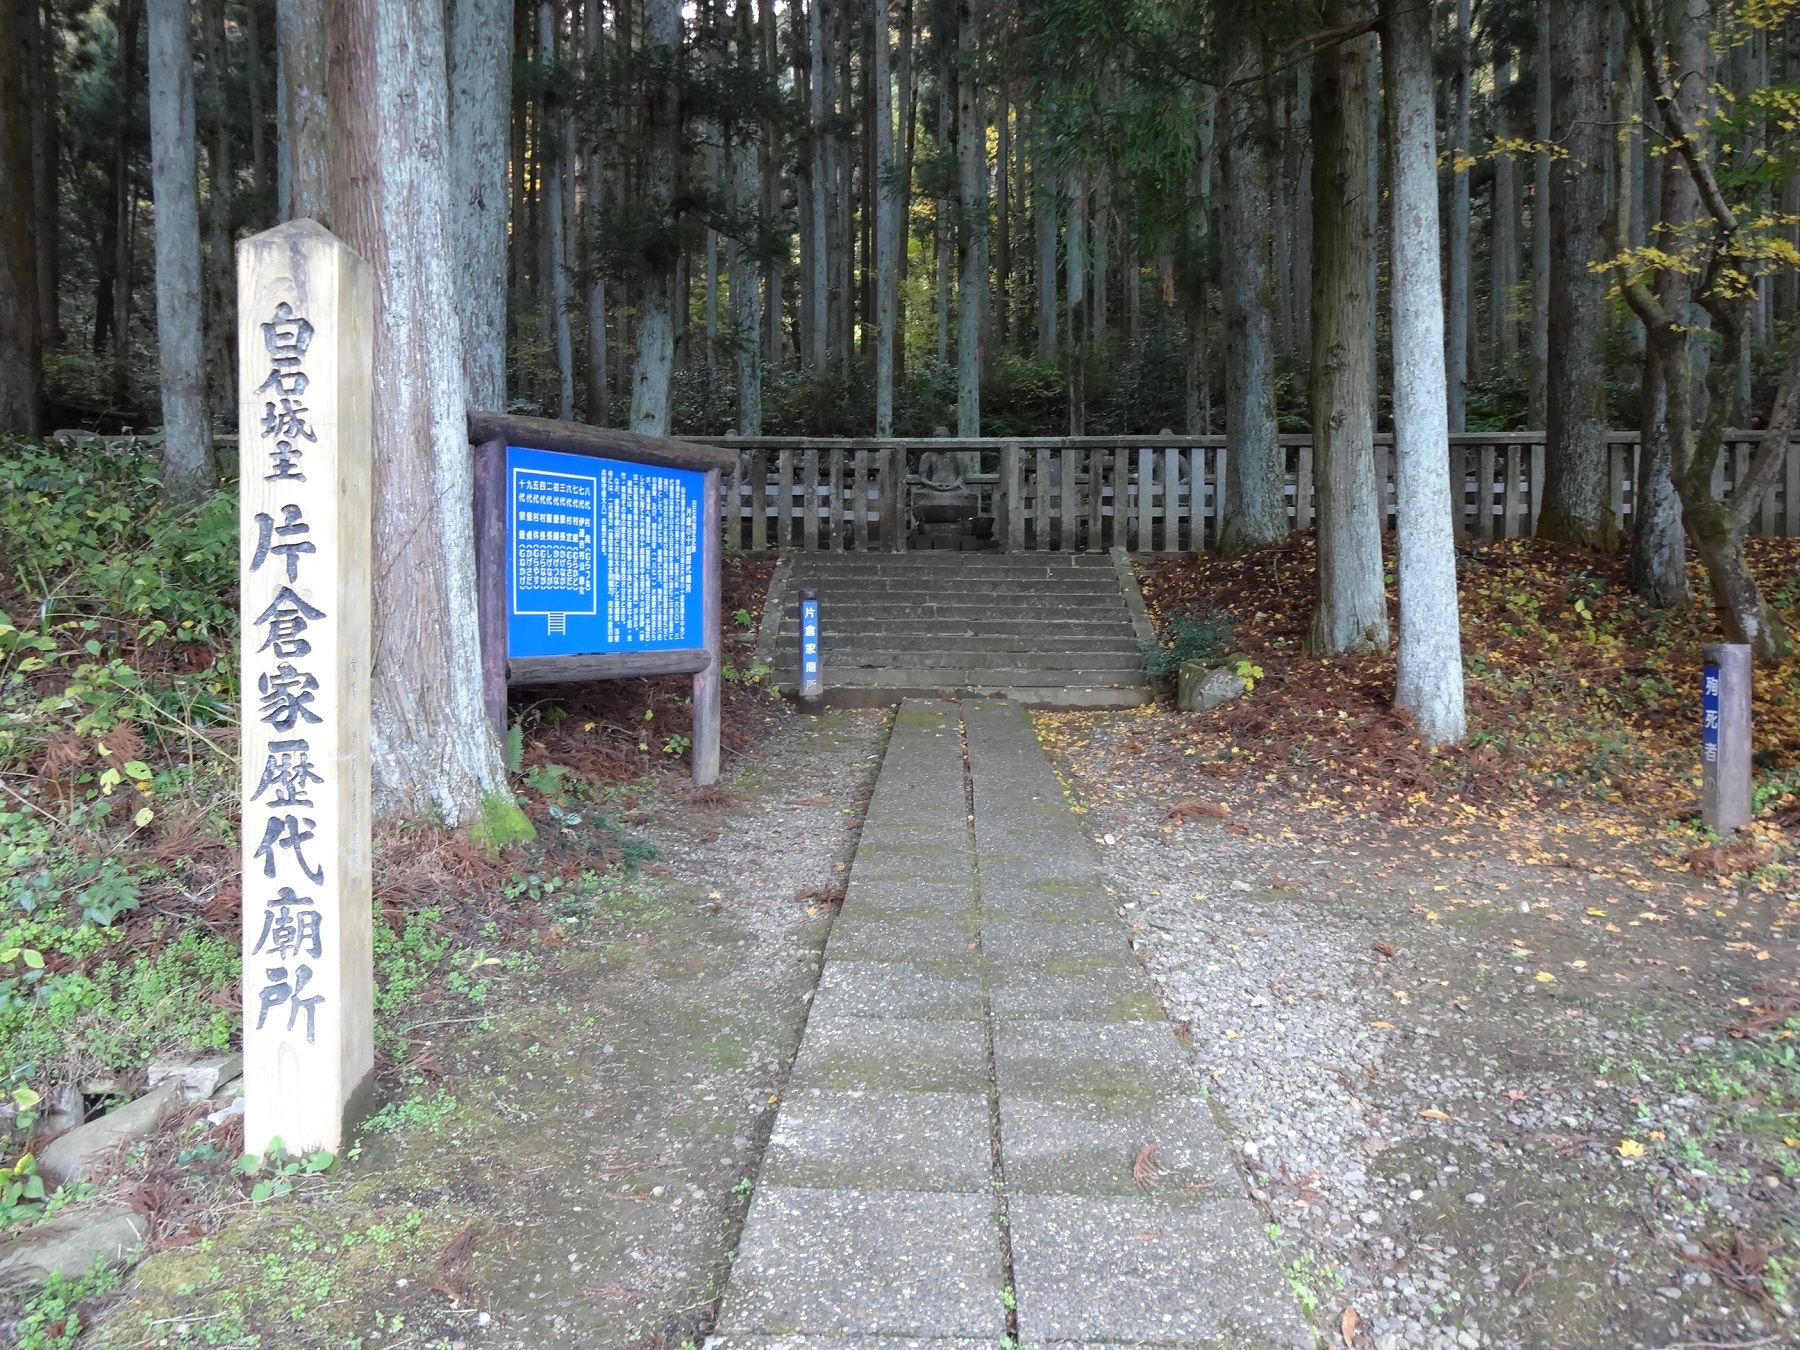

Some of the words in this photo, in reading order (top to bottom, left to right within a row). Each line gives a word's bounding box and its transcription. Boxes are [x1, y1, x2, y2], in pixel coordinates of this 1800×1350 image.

[249, 503, 326, 1046] 片倉家歴代廟所
